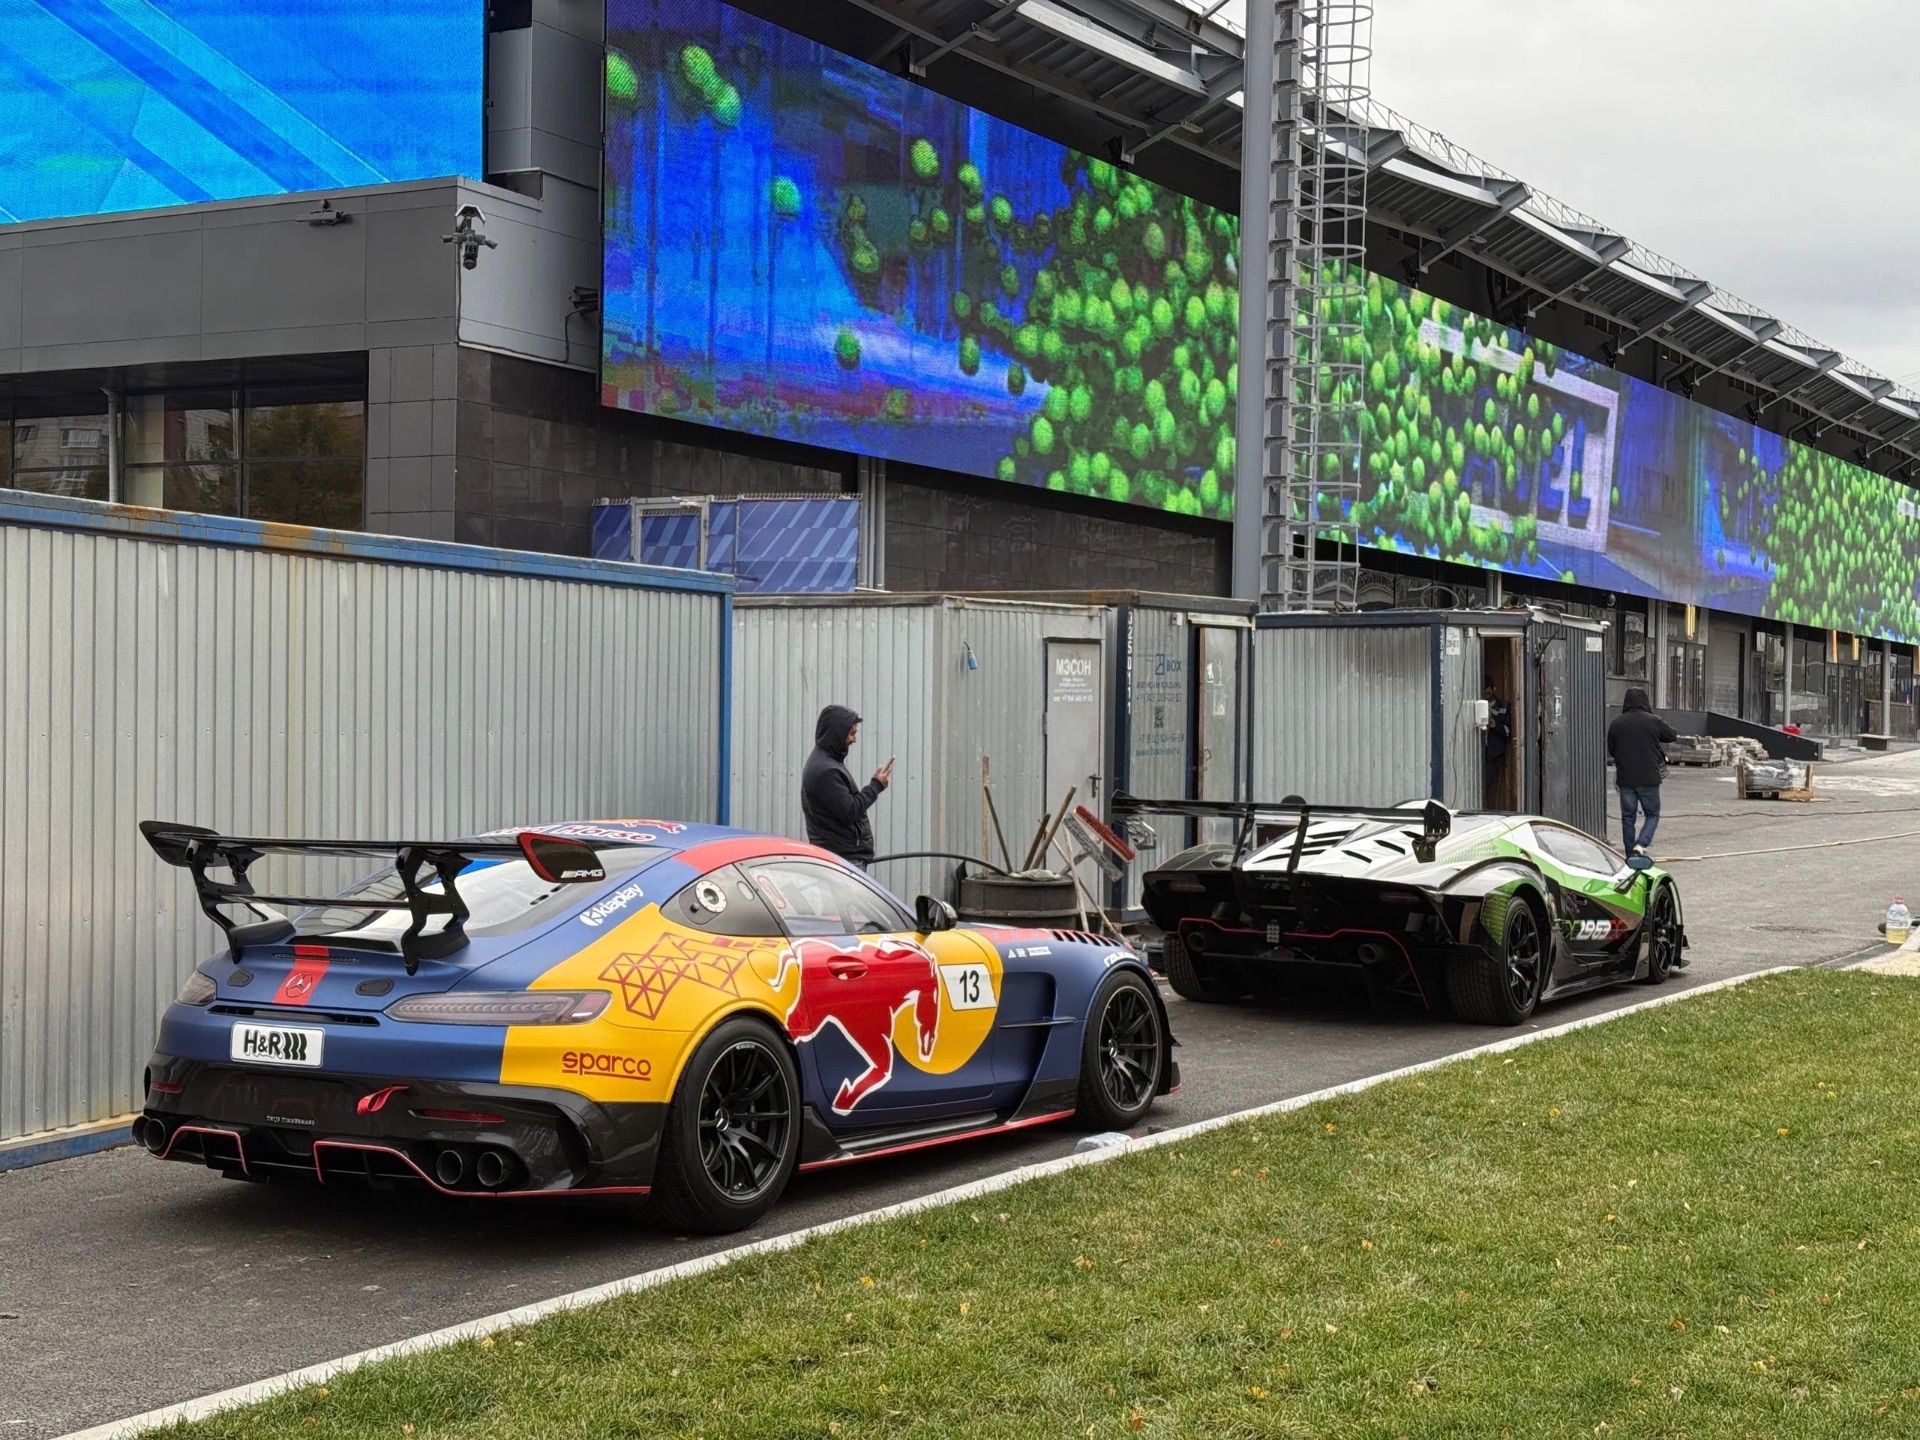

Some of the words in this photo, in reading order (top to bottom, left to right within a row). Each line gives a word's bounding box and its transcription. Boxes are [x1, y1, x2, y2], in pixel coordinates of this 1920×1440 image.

[1056, 659, 1091, 675] МЭСОН
[1166, 660, 1182, 672] BOX
[556, 825, 656, 842] Horse
[575, 869, 603, 877] AMG
[959, 970, 979, 1002] 13
[244, 1029, 282, 1057] H&R
[562, 1051, 651, 1077] sparco
